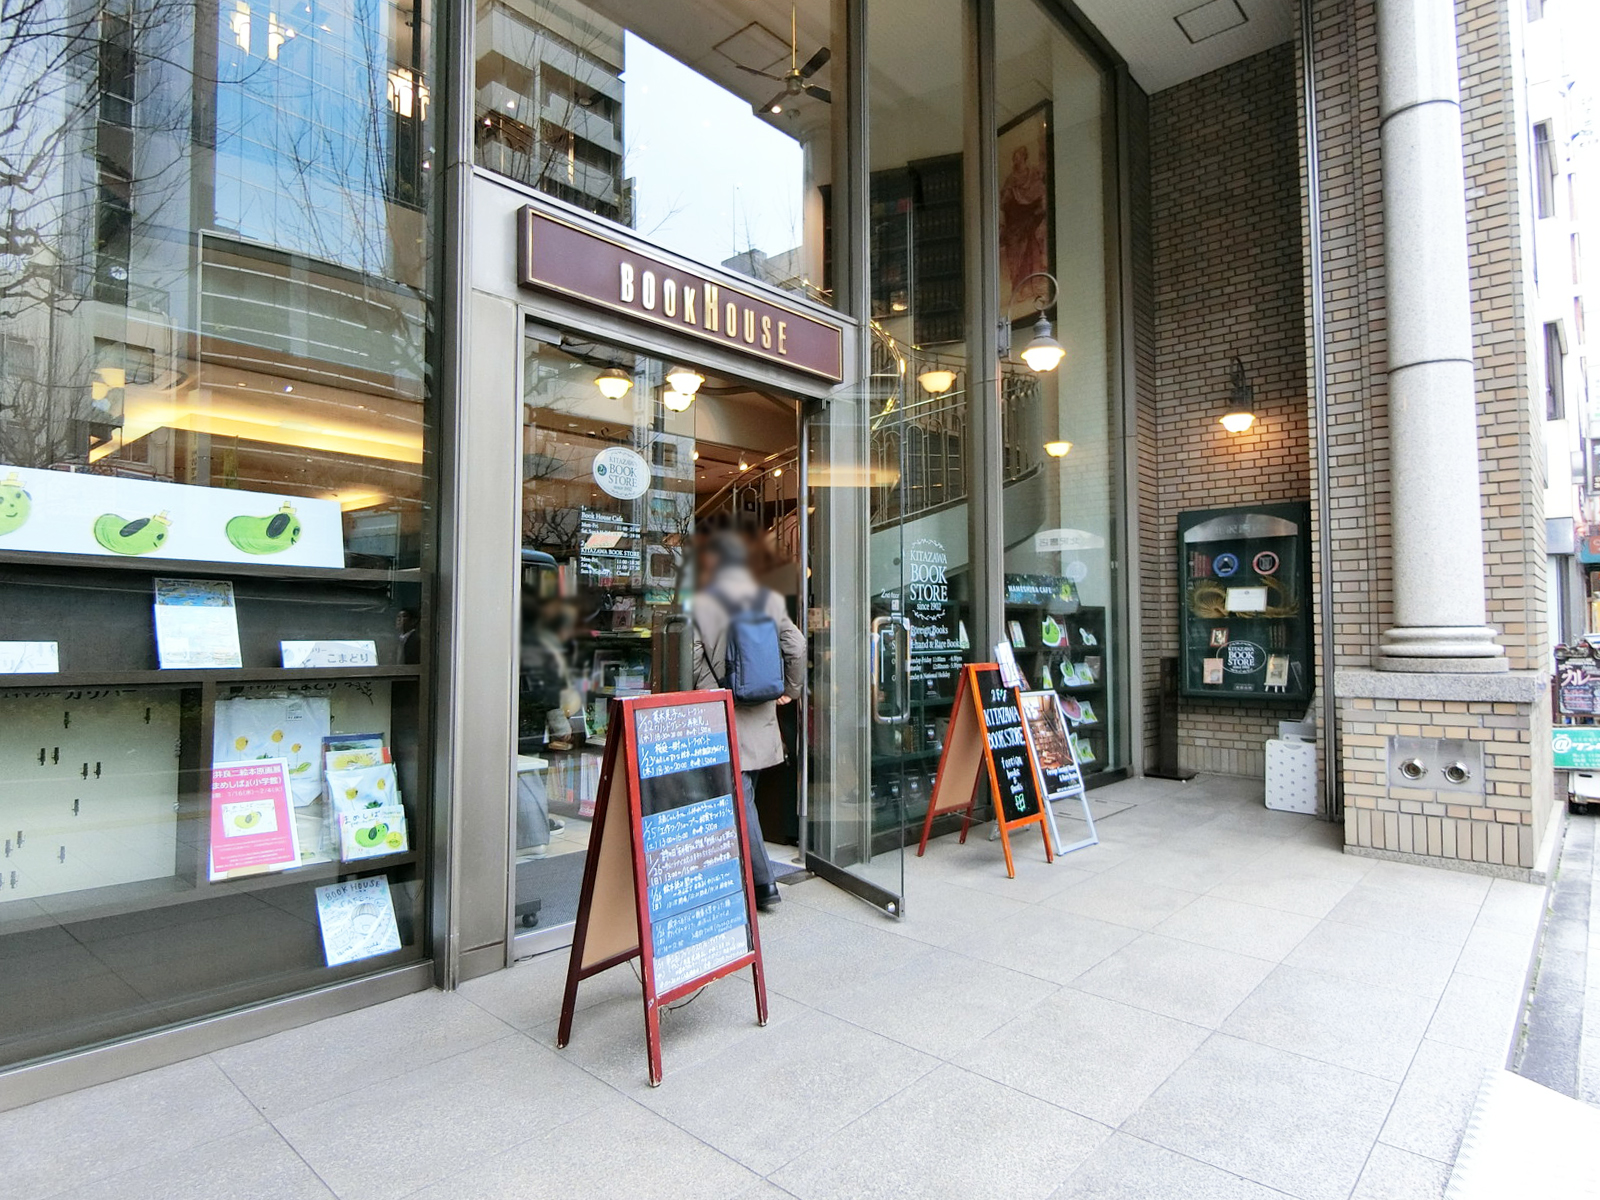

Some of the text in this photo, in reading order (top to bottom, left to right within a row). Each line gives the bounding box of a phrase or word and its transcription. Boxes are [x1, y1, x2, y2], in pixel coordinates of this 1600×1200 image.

[609, 464, 638, 478] BOOK
[608, 475, 638, 487] STORE
[910, 549, 948, 564] KITAZAWA
[911, 563, 948, 584] BOOK
[909, 583, 948, 602] STORE
[1039, 586, 1052, 594] CAFE
[916, 602, 930, 611] since
[935, 639, 946, 649] Rare
[1228, 651, 1254, 660] BOOK
[1228, 658, 1254, 666] STORE
[983, 705, 1021, 727] KITAZAWA
[325, 879, 381, 901] BOOK HOUSE
